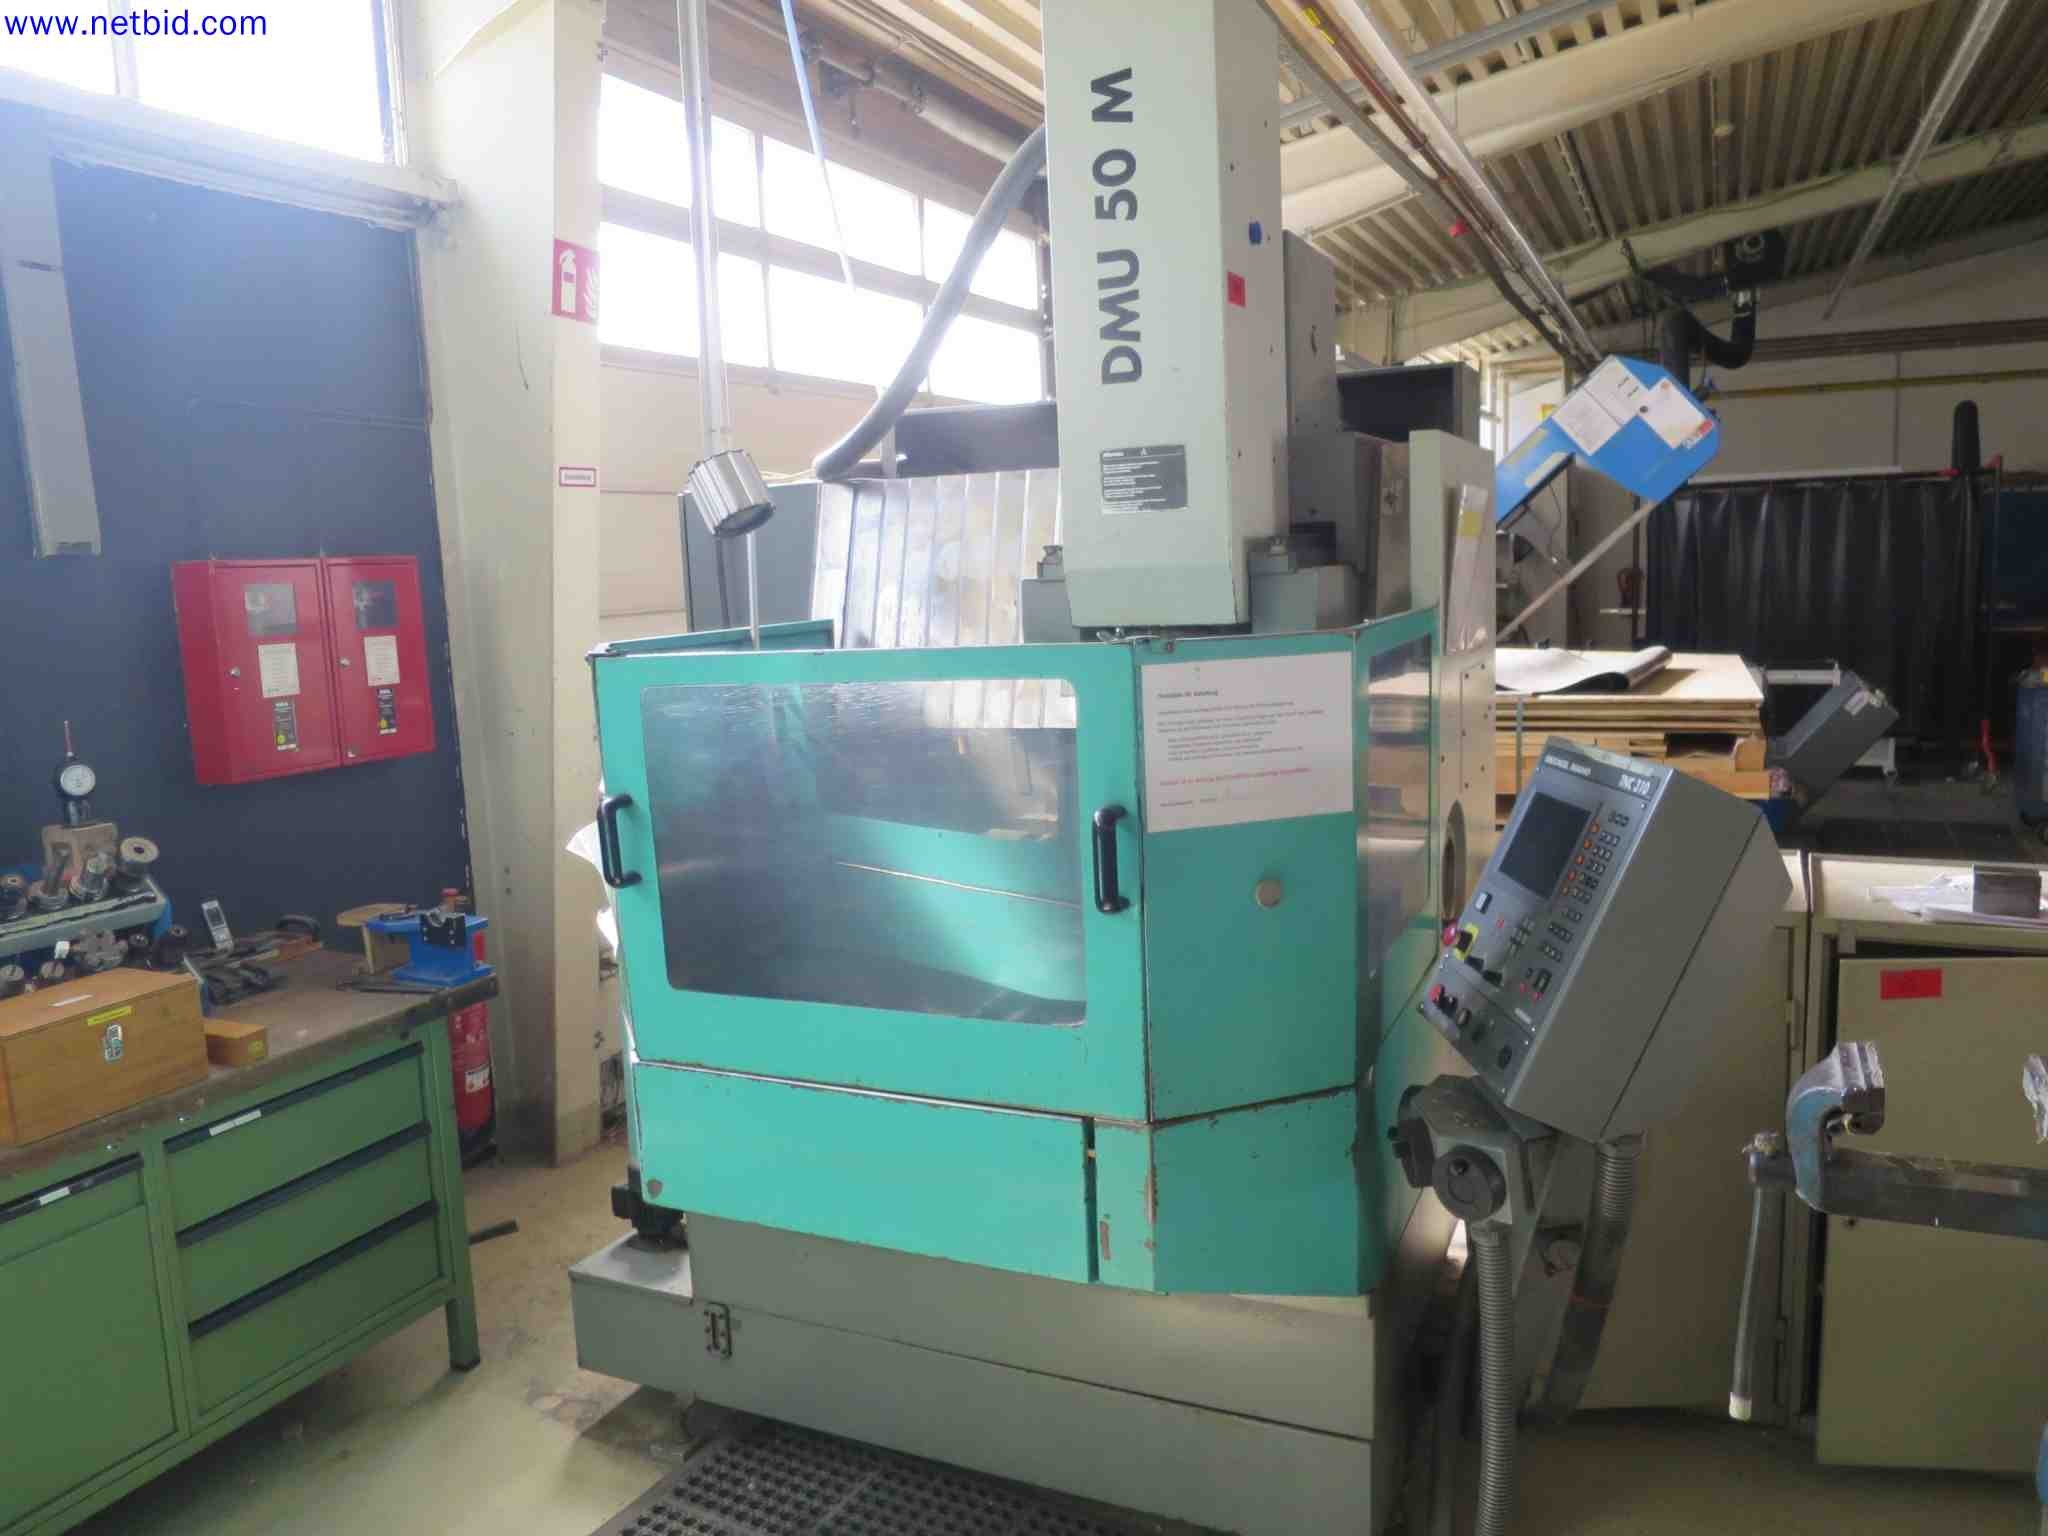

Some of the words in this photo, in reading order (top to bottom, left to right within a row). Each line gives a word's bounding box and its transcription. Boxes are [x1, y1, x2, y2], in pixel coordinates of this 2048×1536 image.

[1090, 67, 1133, 123] M
[1092, 148, 1138, 221] 50
[1096, 248, 1142, 385] DMU
